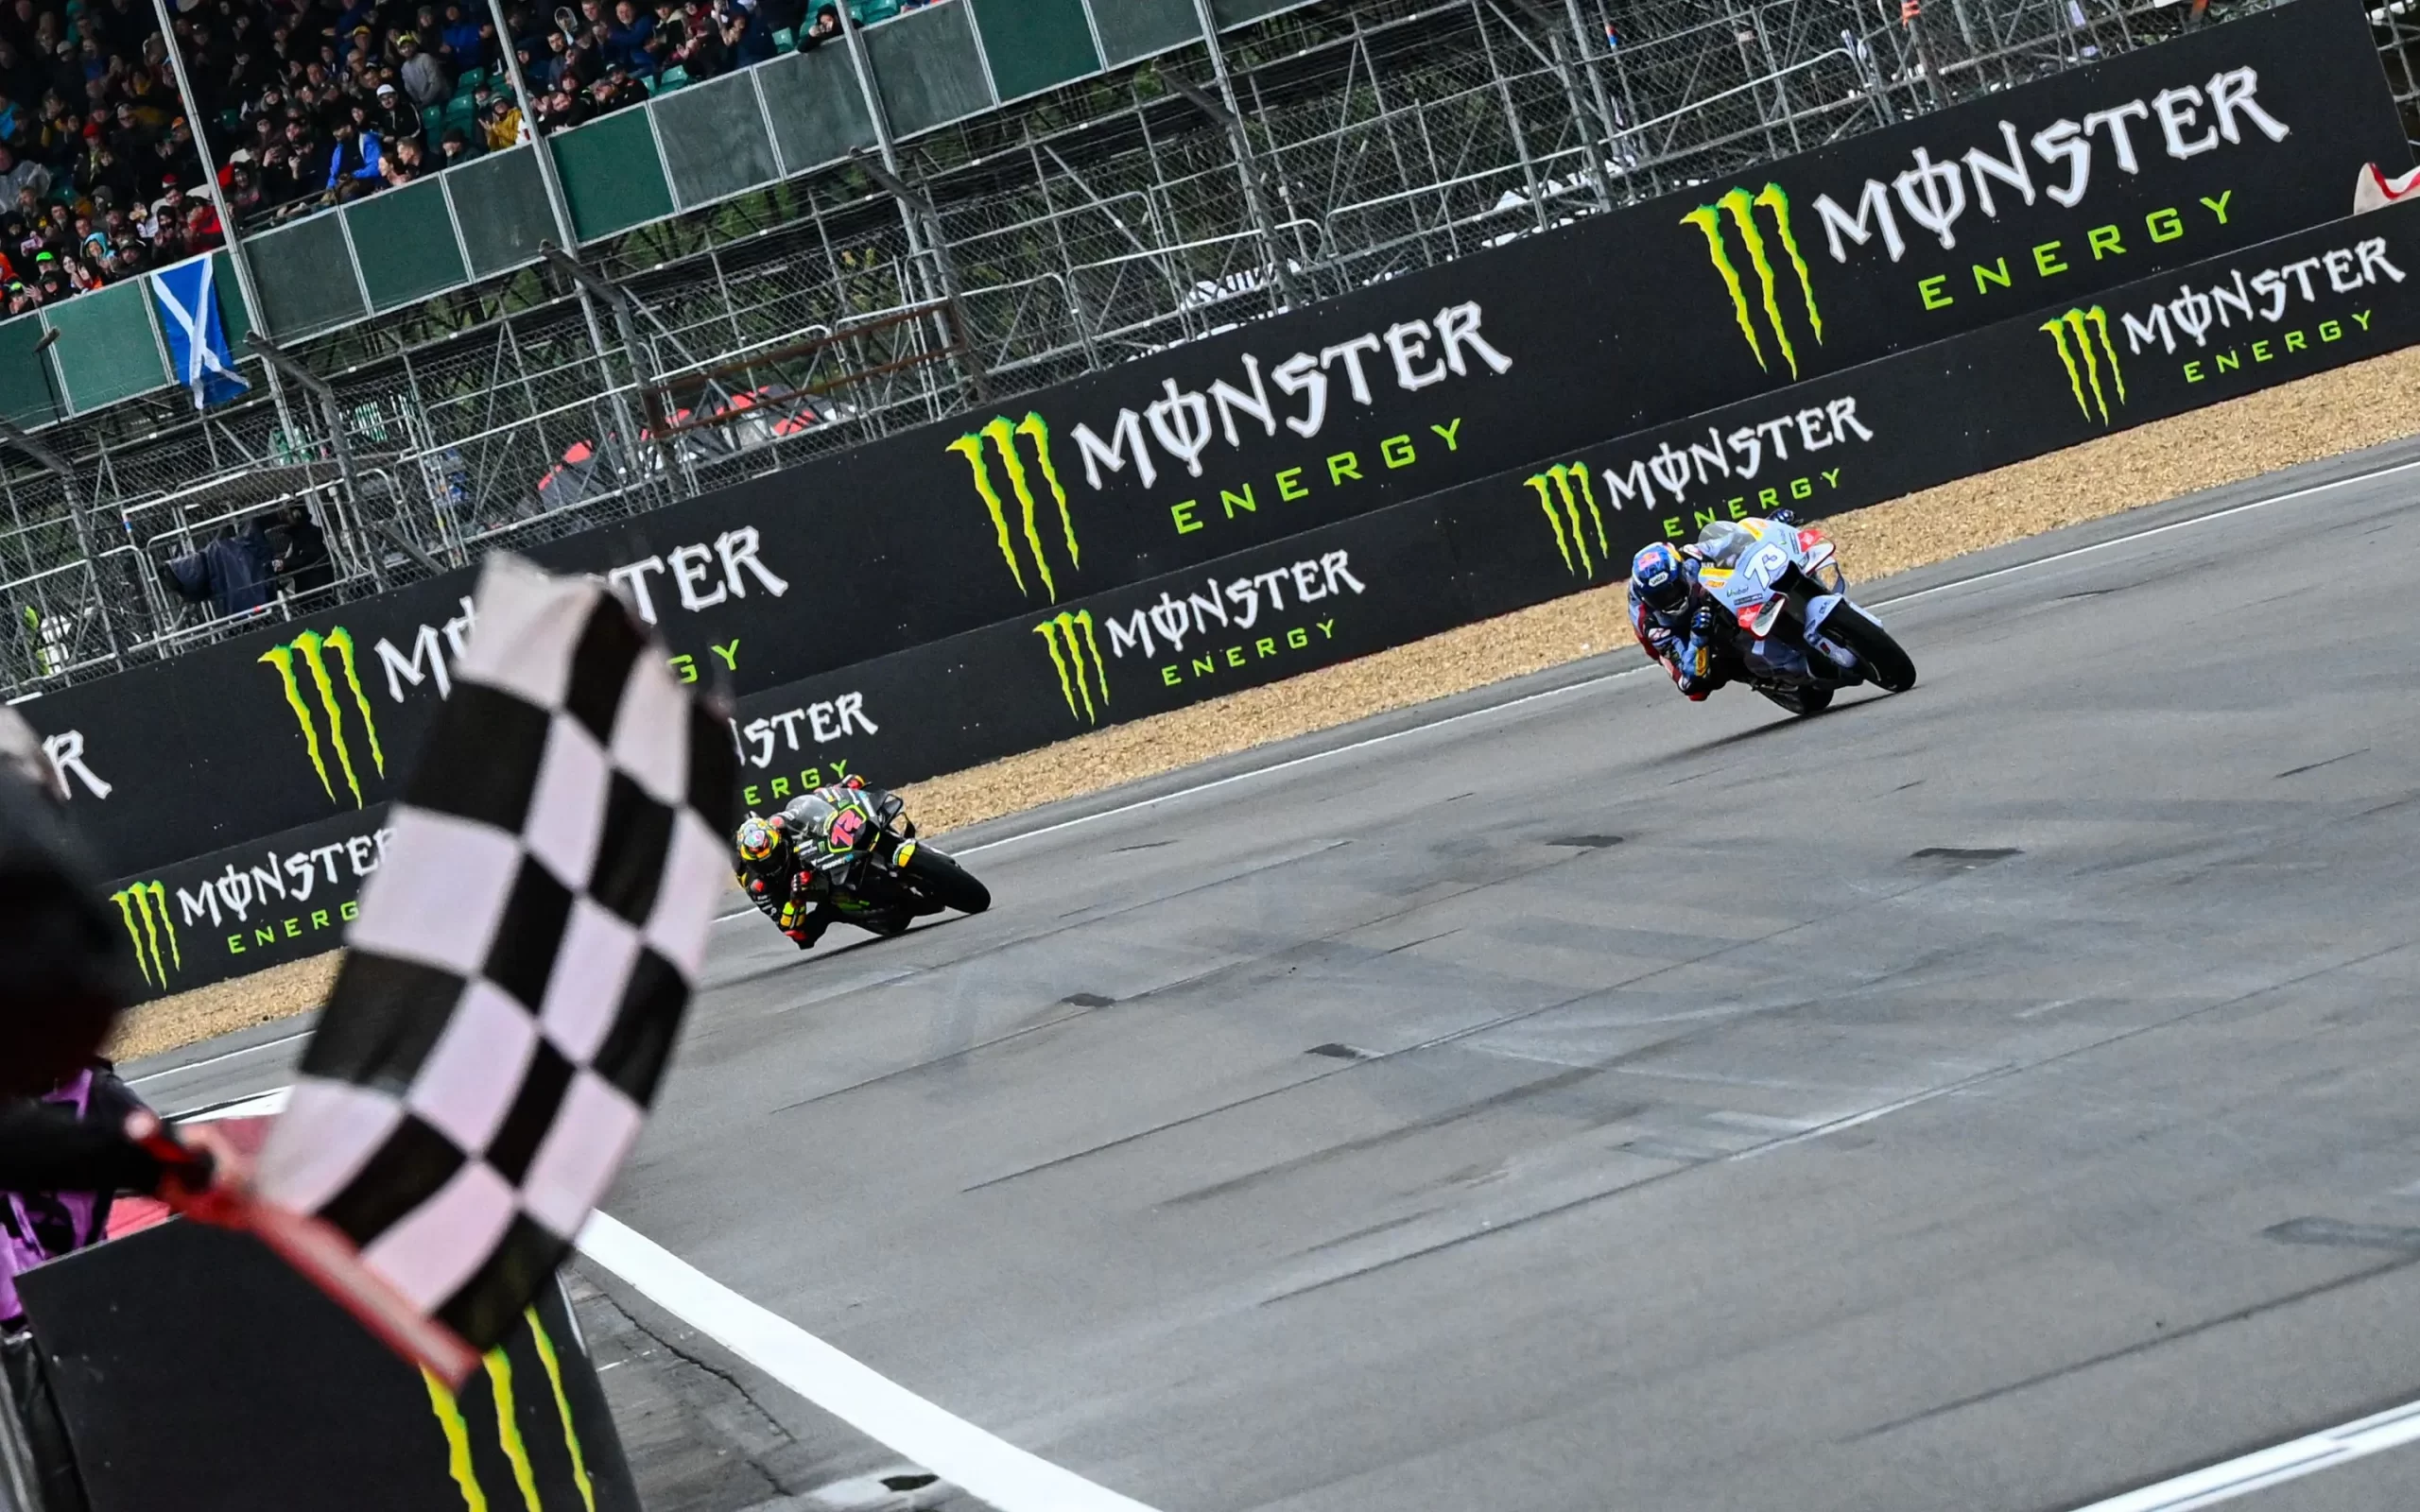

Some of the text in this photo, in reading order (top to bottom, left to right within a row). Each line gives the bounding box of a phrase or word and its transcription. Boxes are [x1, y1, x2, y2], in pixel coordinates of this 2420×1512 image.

[1811, 65, 2290, 264] MONSTER
[1919, 191, 2232, 311] ENERGY
[2121, 236, 2407, 355] MONSTER
[1070, 300, 1513, 490] MONSTER
[2185, 310, 2373, 383] ENERGY
[1171, 418, 1461, 535] ENERGY
[1601, 396, 1875, 511] MONSTER
[1663, 467, 1841, 538] ENERGY
[1104, 548, 1366, 661] MONSTER
[1161, 617, 1338, 686] ENERGY
[743, 759, 848, 806] ERGY
[228, 900, 359, 954] ENERG
